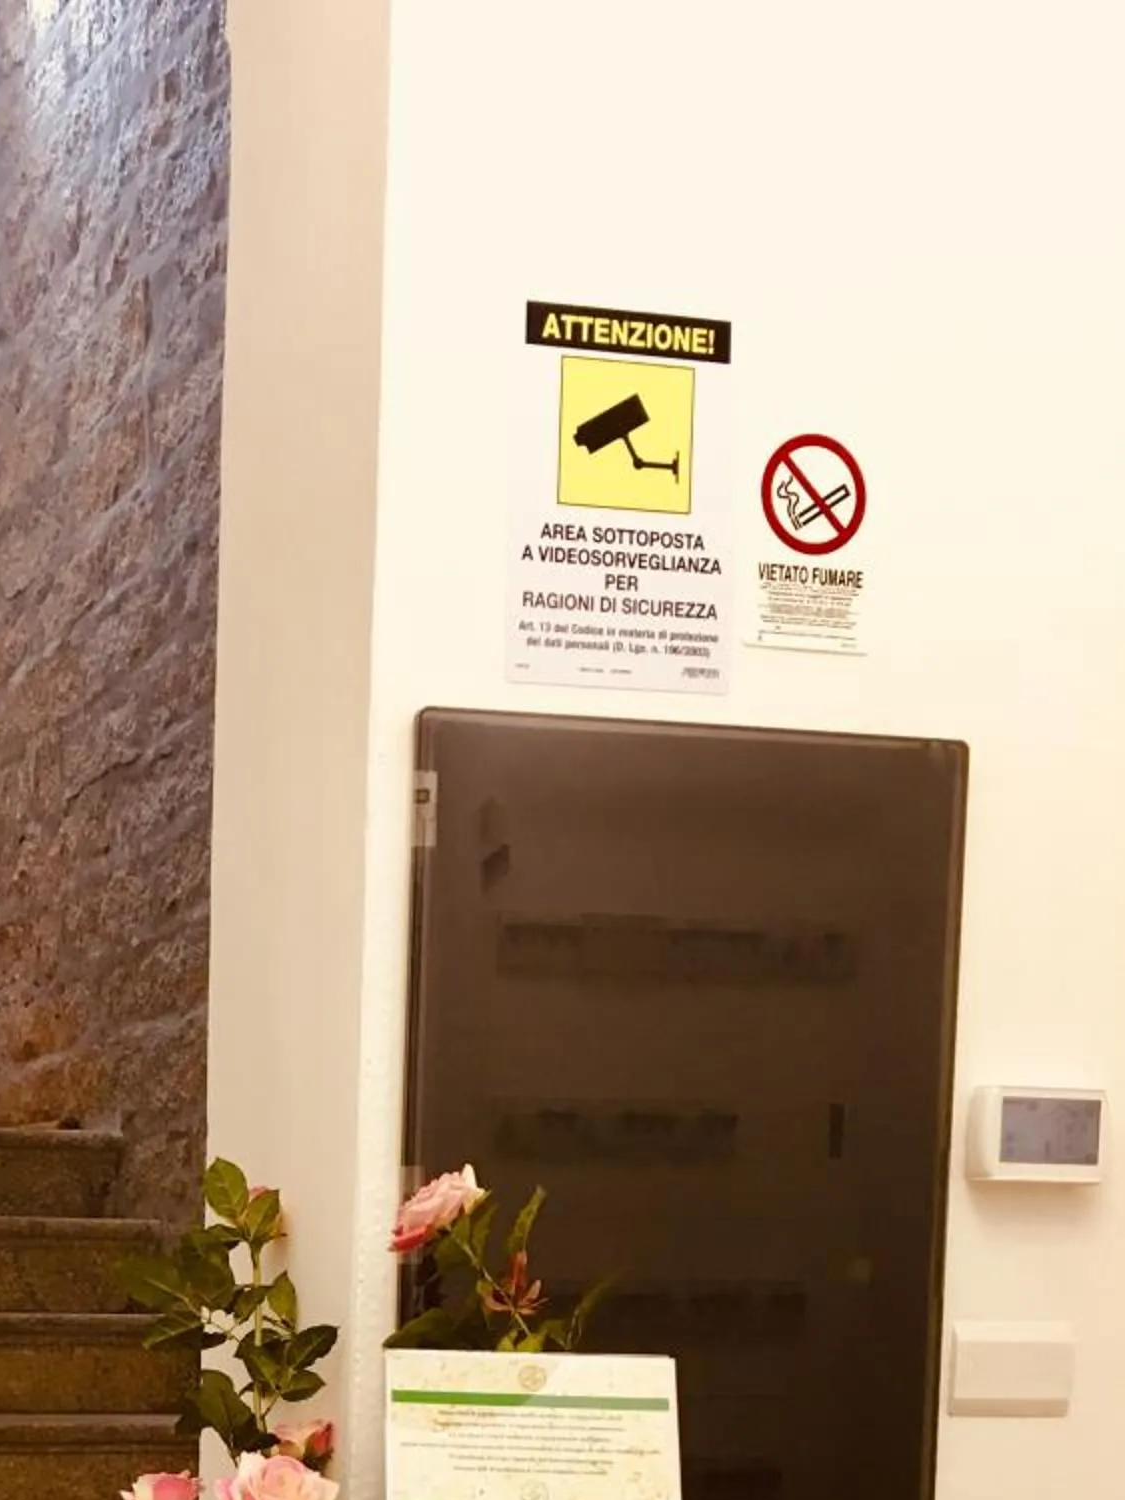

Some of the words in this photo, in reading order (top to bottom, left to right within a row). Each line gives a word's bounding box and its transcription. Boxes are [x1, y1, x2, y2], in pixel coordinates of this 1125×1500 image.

[542, 313, 715, 354] ATTENZIONE!
[540, 523, 588, 542] AREA
[592, 527, 705, 550] SOTTOPOSTA
[521, 544, 534, 561] A
[538, 545, 722, 575] VIDEOSORVEGLIANZA
[604, 573, 639, 592] PER
[758, 562, 809, 584] VIETATO
[812, 567, 864, 589] FUMARE
[522, 591, 595, 612] RAGIONI
[600, 596, 616, 613] DI
[621, 597, 718, 620] SICUREZZA
[571, 623, 604, 636] Codice
